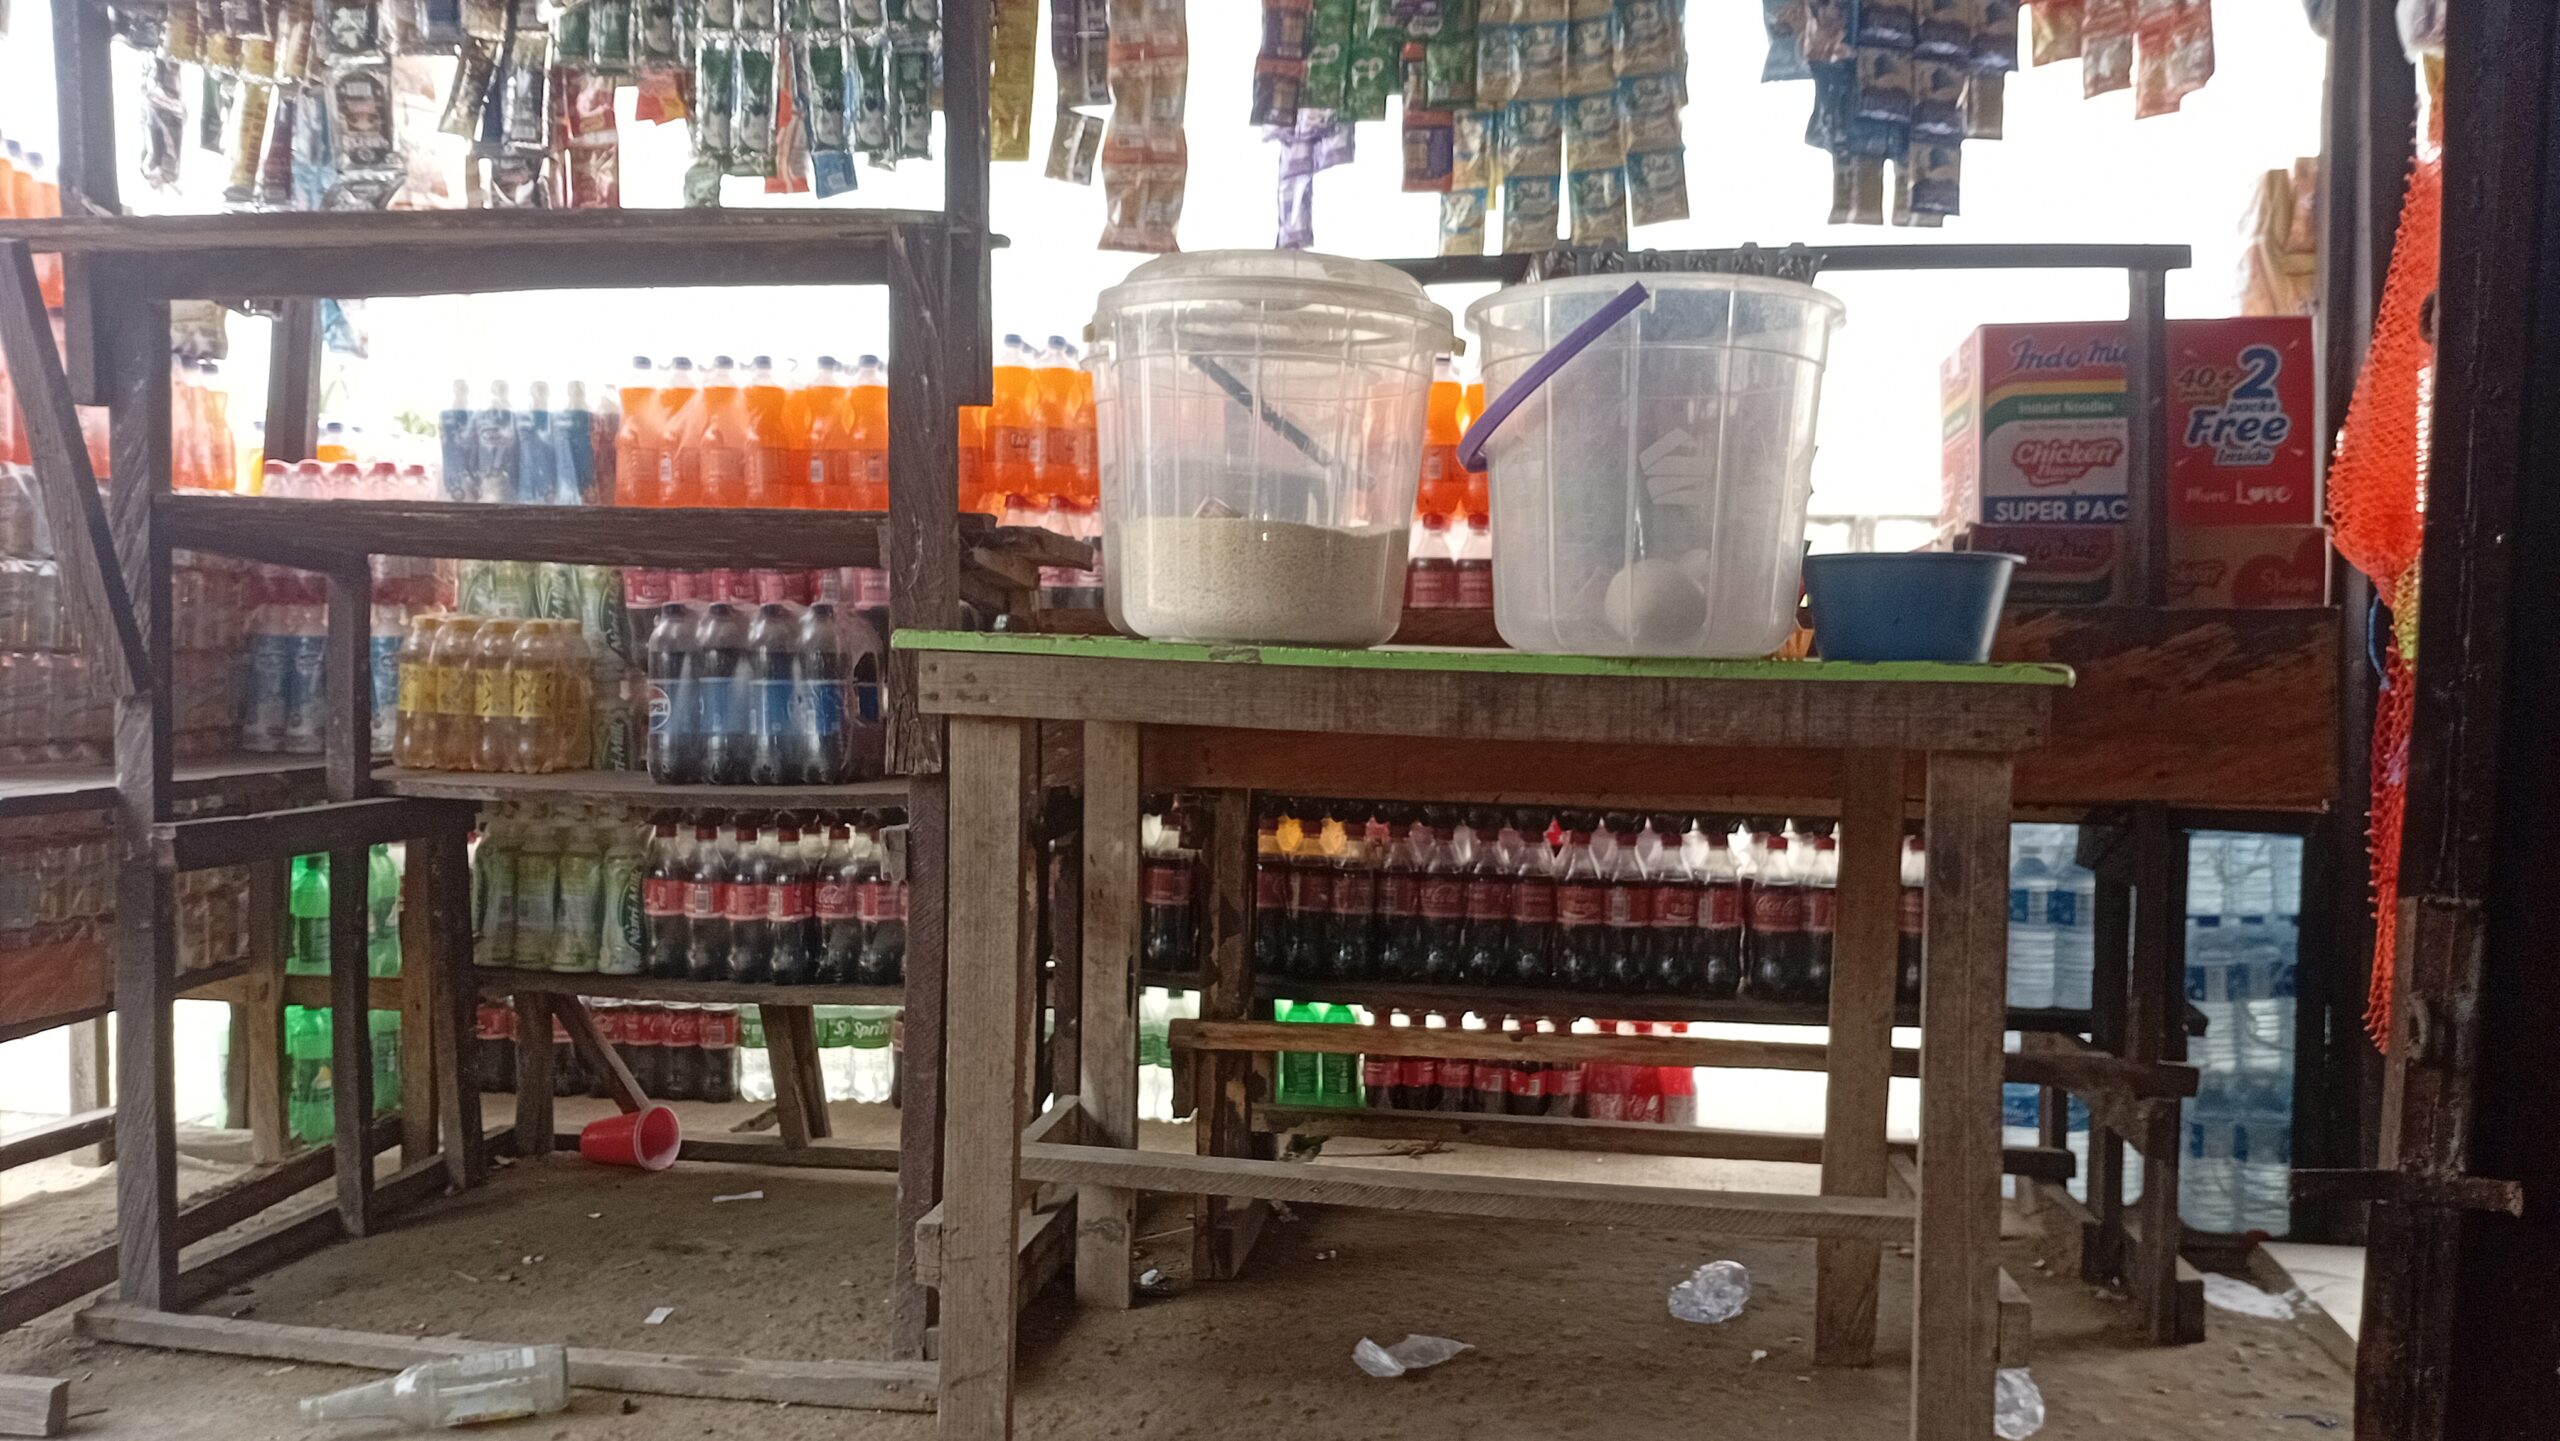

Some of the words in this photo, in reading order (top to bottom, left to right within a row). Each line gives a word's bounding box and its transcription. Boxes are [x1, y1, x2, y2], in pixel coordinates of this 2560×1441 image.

[2231, 346, 2279, 400] 2
[2187, 410, 2287, 444] Free
[2014, 438, 2118, 466] Chicken
[1995, 502, 2067, 521] SUPER
